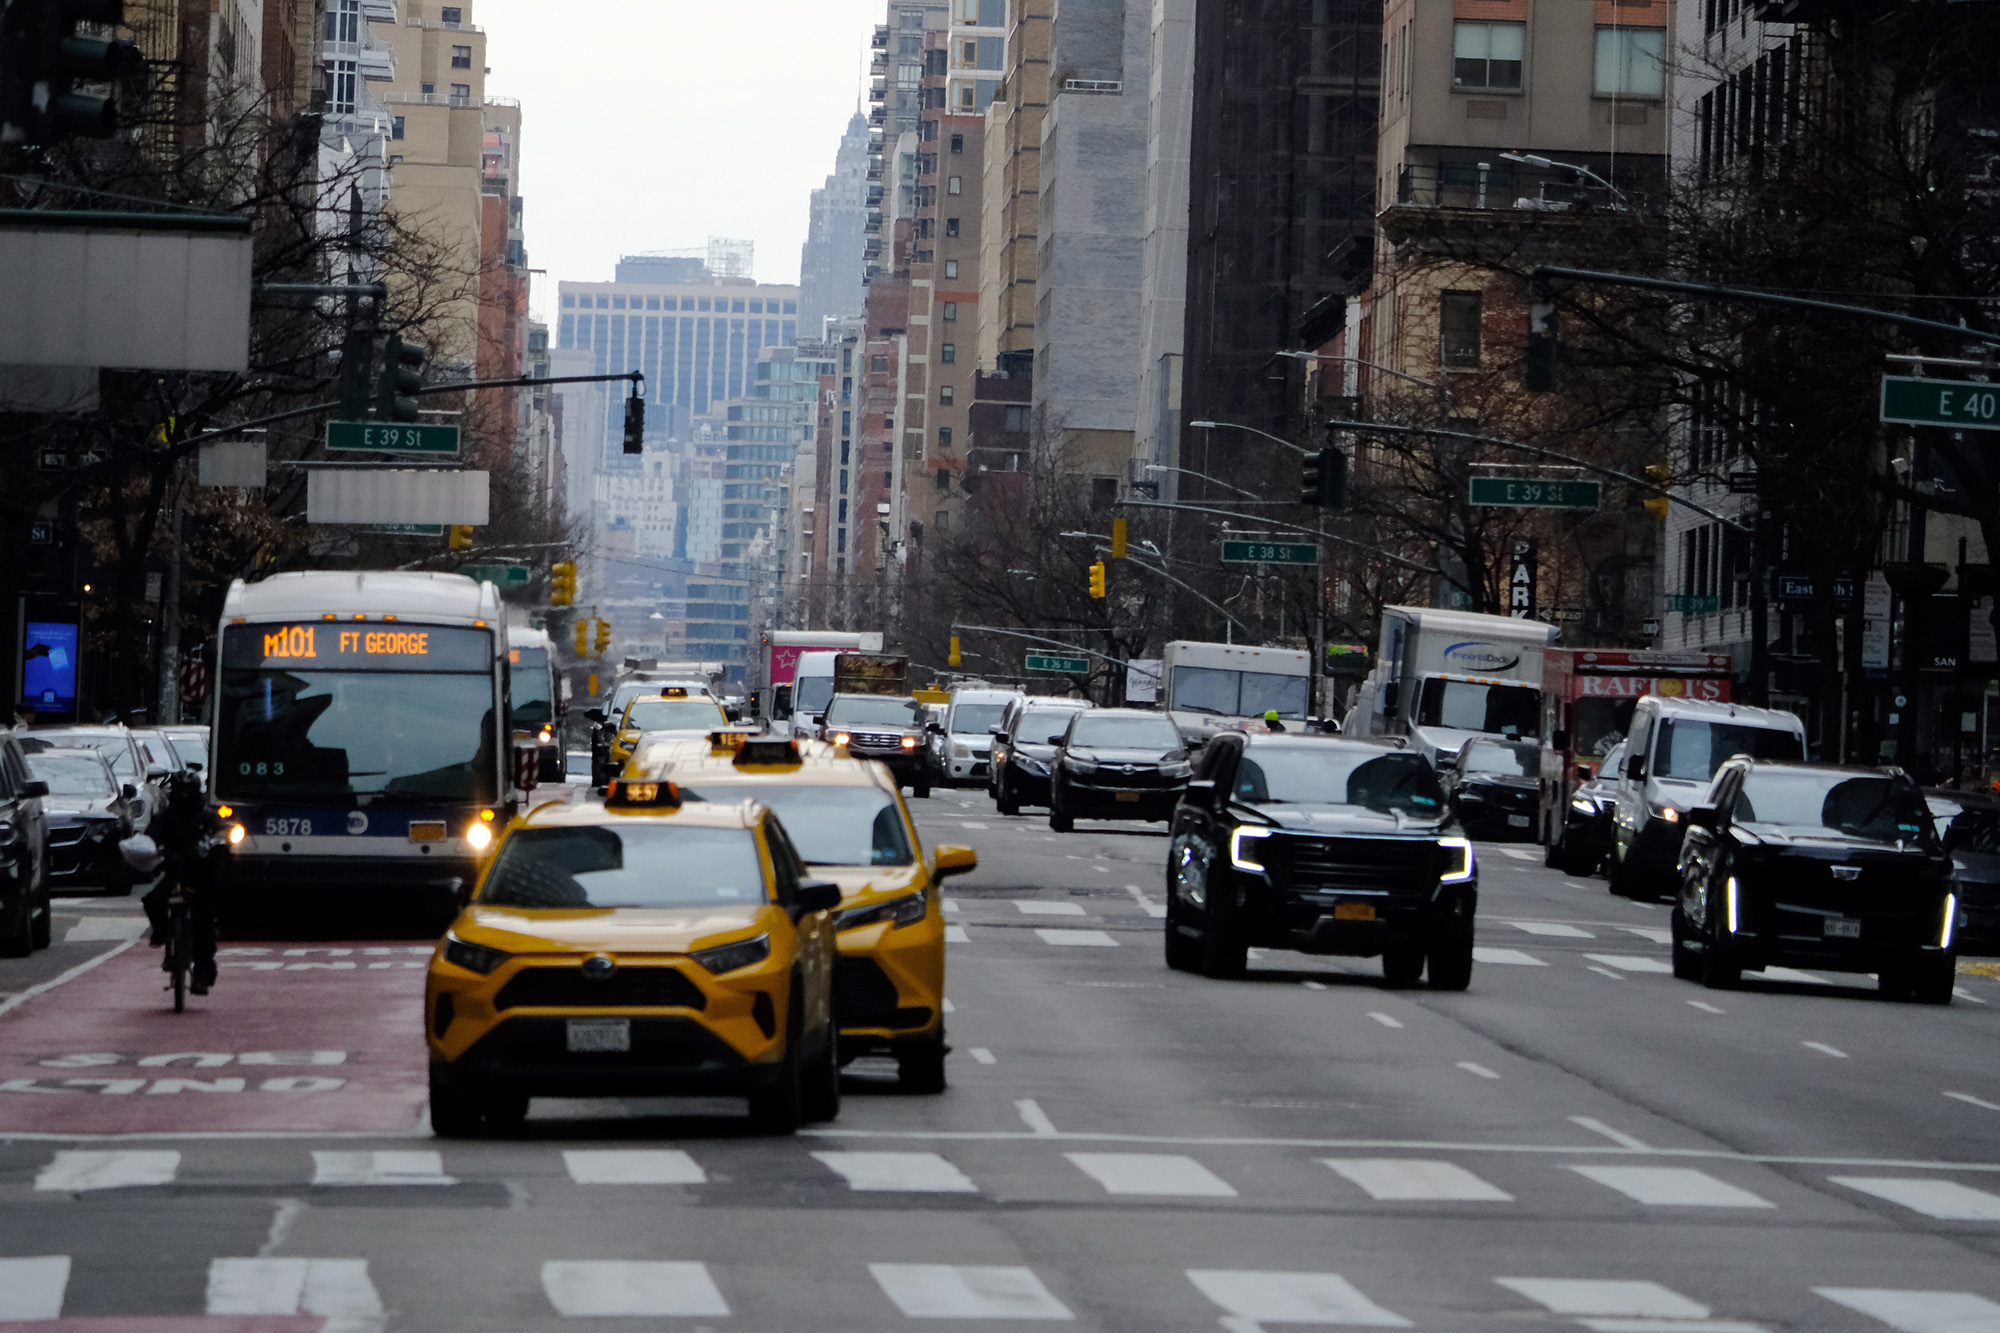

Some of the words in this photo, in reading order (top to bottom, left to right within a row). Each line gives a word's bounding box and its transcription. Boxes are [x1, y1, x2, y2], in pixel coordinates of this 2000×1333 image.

[1939, 391, 1953, 416] E
[1963, 393, 1995, 419] 40
[364, 428, 373, 445] E
[380, 429, 398, 446] 39
[405, 430, 421, 446] St
[1507, 484, 1516, 500] E
[1522, 485, 1541, 501] 39
[1547, 486, 1563, 502] St
[31, 529, 47, 541] St
[1248, 545, 1255, 558] E
[1260, 546, 1274, 559] 38
[1279, 547, 1291, 560] St
[1784, 581, 1815, 595] East
[263, 625, 317, 658] M101
[340, 631, 360, 653] FT
[365, 632, 428, 655] GEORGE
[1043, 659, 1048, 668] E
[1934, 657, 1956, 667] SAN
[265, 817, 312, 836] 5878
